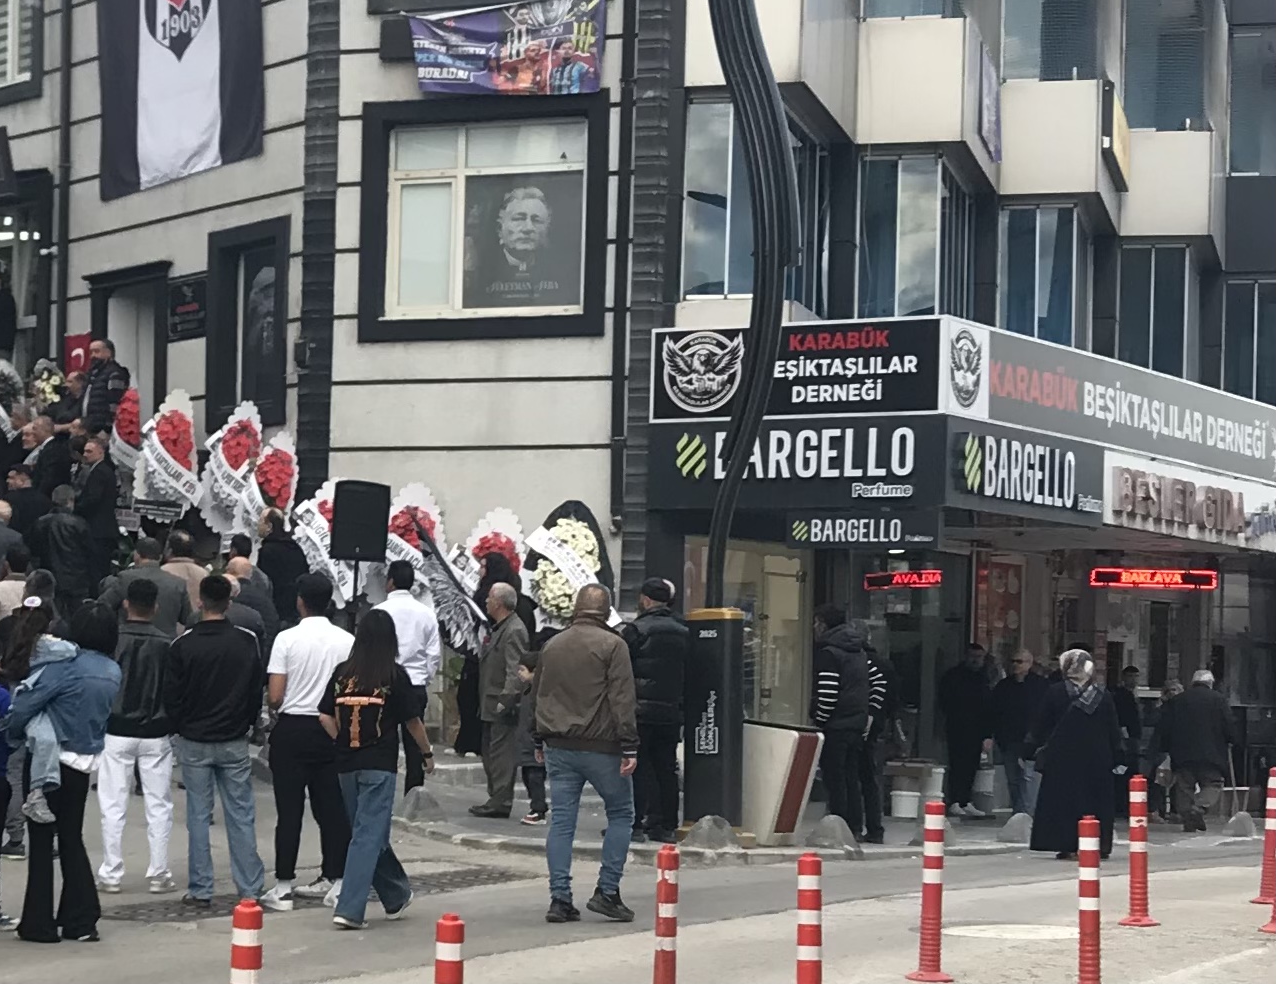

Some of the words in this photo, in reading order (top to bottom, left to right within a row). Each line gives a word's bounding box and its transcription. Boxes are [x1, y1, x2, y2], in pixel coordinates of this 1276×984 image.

[161, 5, 200, 41] 1903
[789, 326, 890, 351] KARABÜK
[773, 355, 918, 381] EŞİKTAŞLILAR
[791, 378, 883, 403] DERNEĞİ
[989, 359, 1079, 413] KARABÜK
[1083, 381, 1203, 445] BEŞİKTAŞLILAR
[1206, 418, 1267, 460] DERNEĞİ
[984, 435, 1076, 509] BARGELLO
[851, 482, 914, 498] Perfume
[810, 518, 902, 543] BARGELLO
[1121, 571, 1183, 584] BAKLAVA
